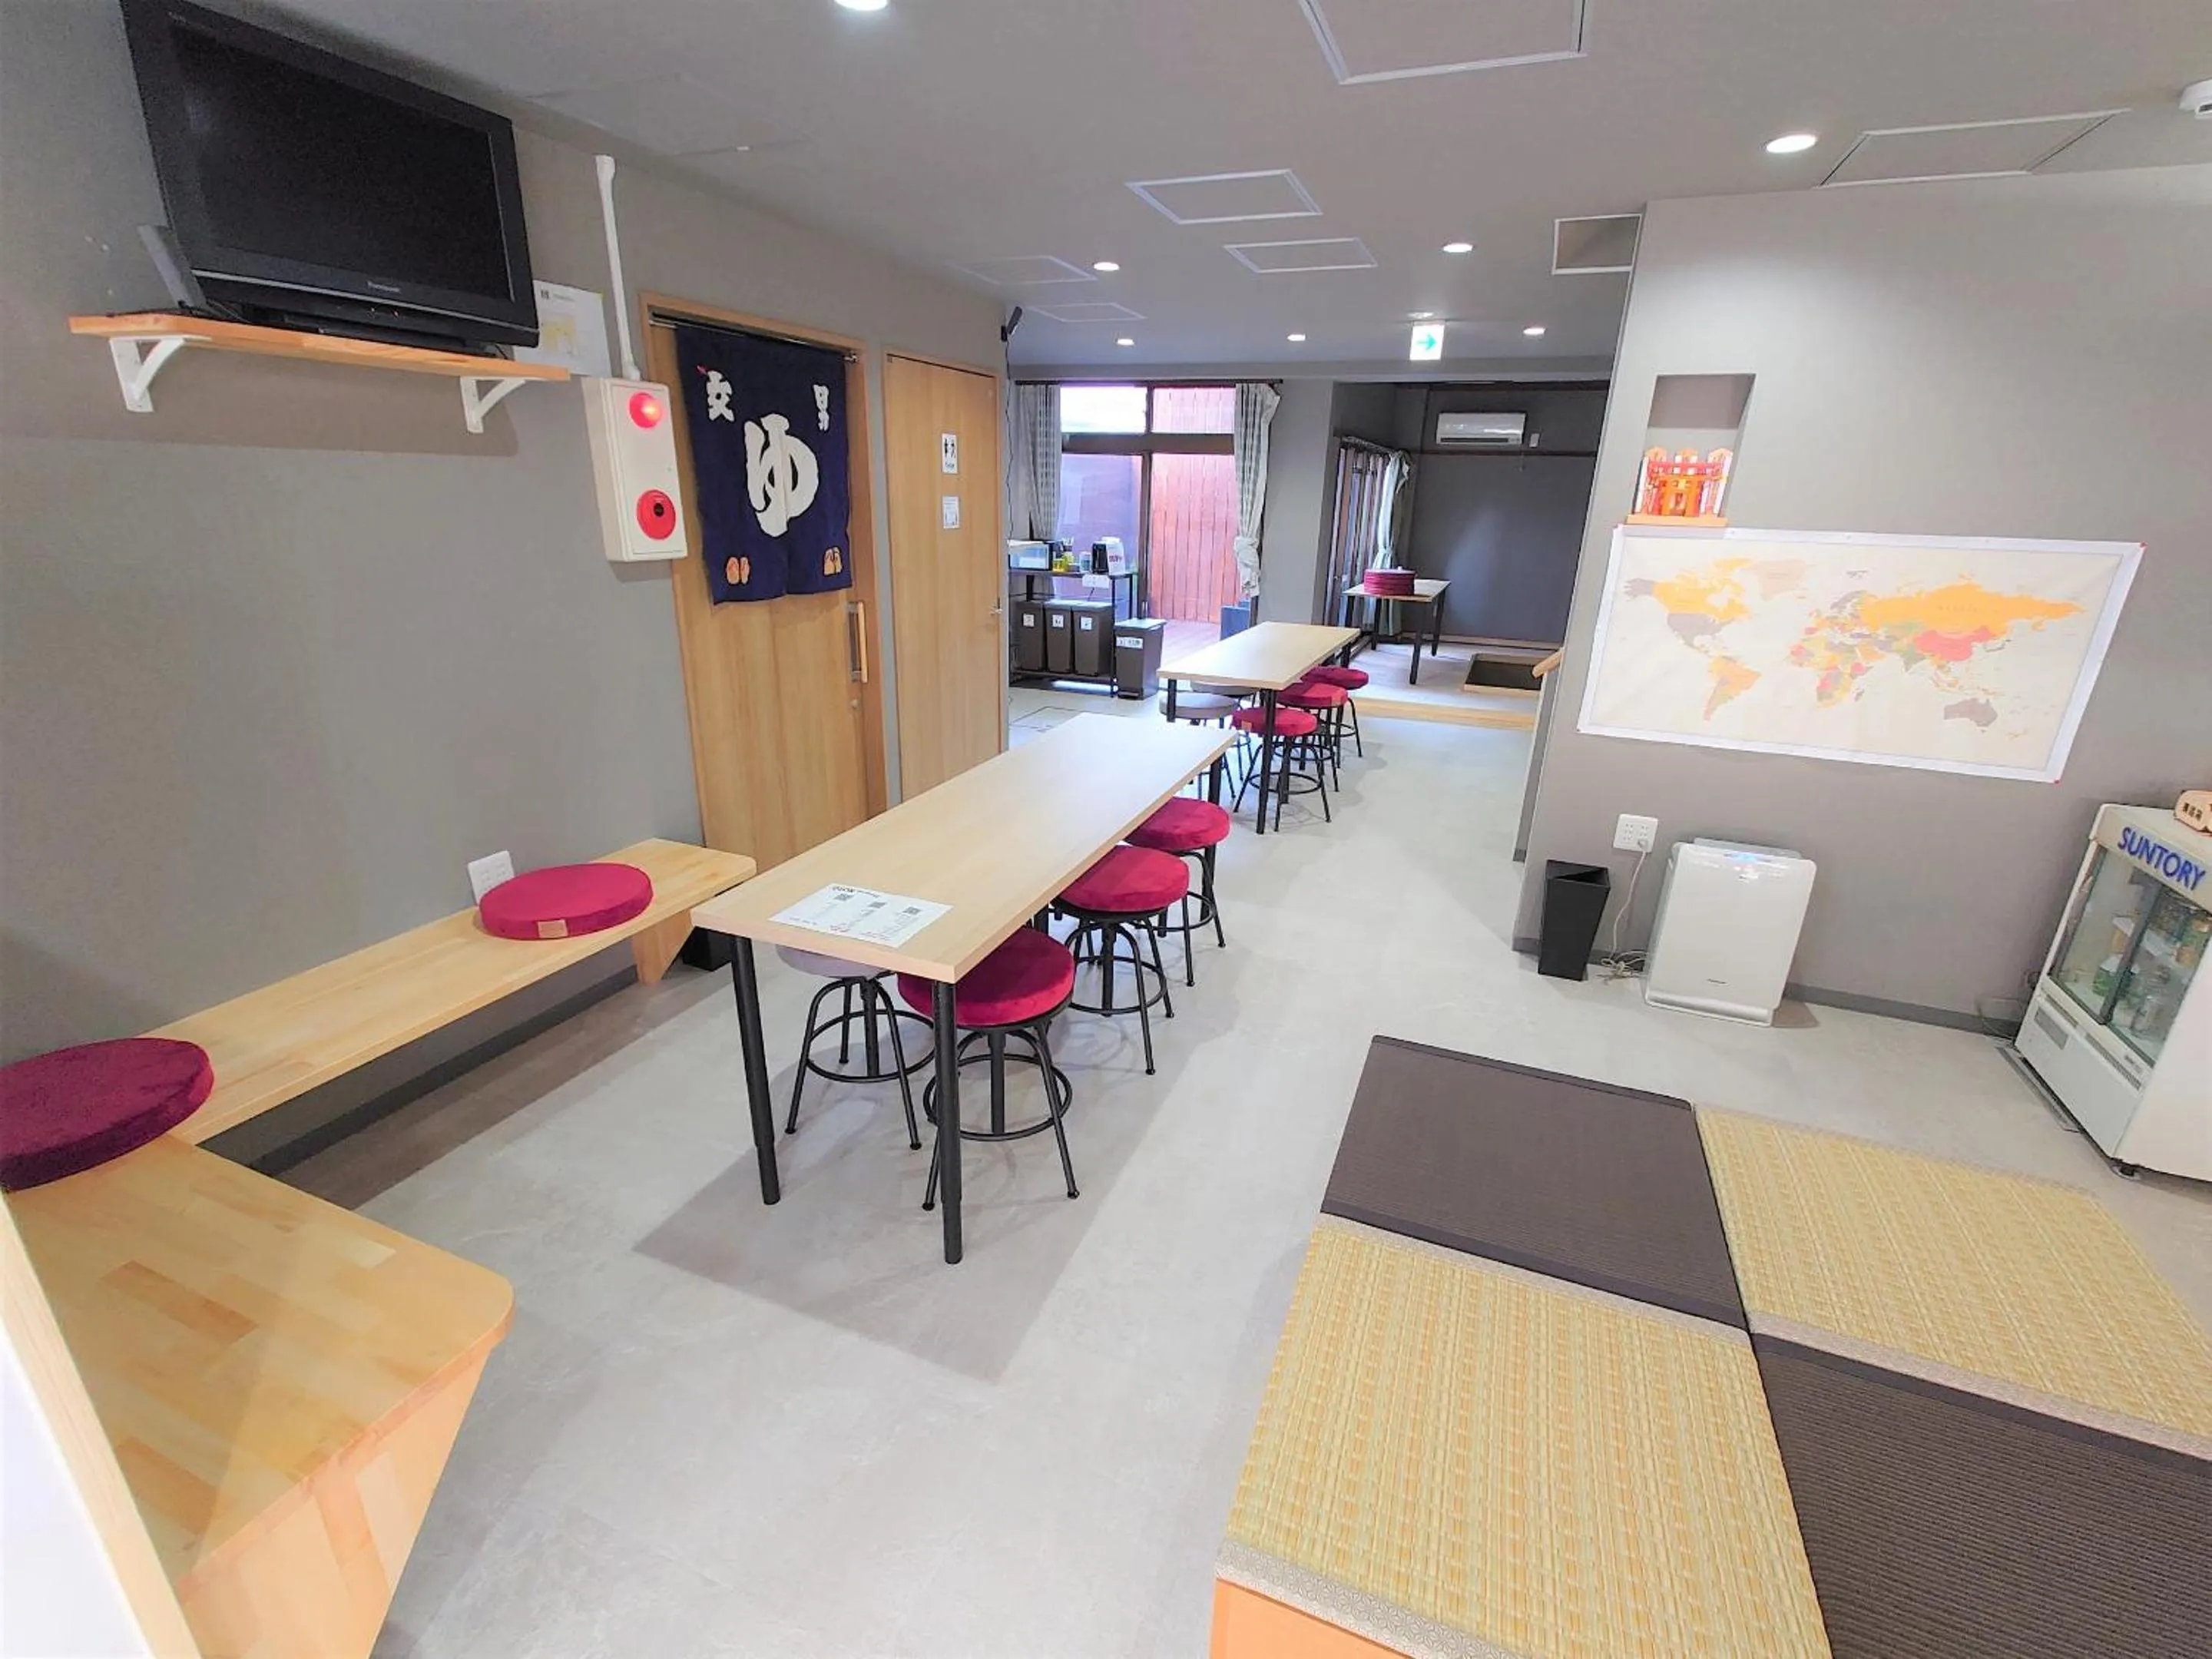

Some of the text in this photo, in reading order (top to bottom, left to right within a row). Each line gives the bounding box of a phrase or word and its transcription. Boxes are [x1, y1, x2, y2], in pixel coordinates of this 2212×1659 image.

[707, 370, 734, 422] 女
[744, 413, 820, 538] ゆ
[2118, 827, 2207, 891] SUNTORY
